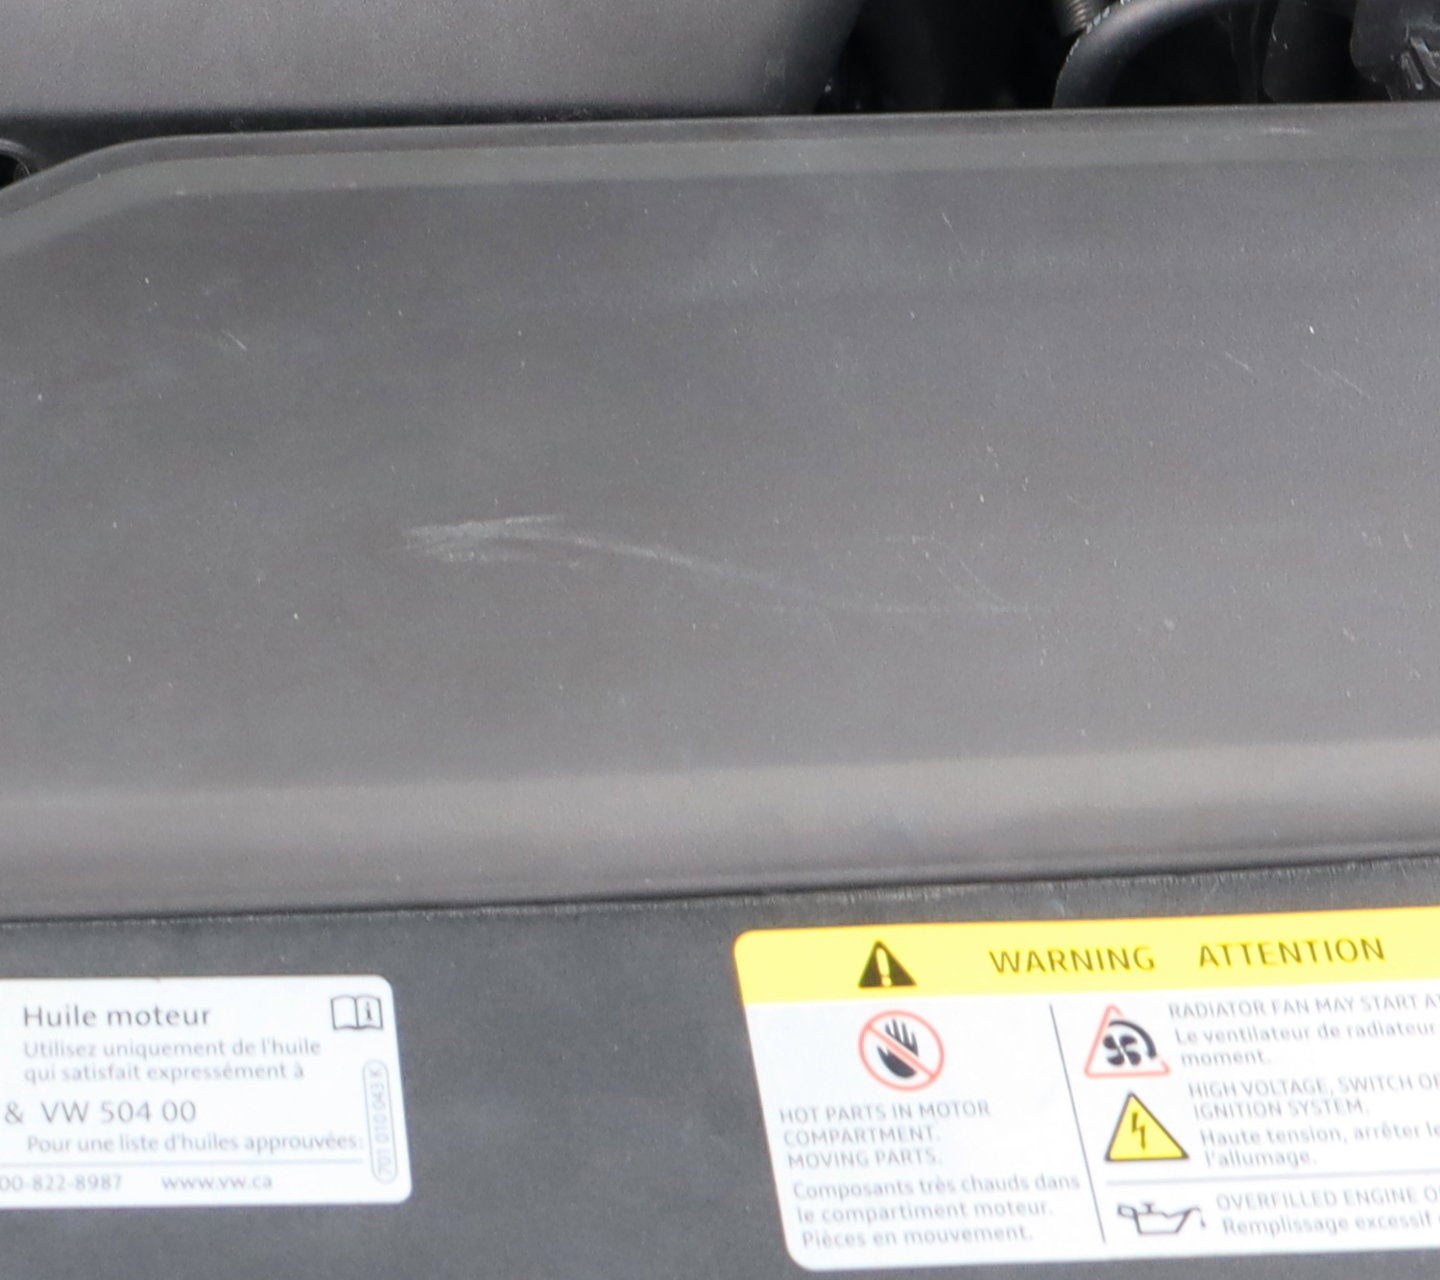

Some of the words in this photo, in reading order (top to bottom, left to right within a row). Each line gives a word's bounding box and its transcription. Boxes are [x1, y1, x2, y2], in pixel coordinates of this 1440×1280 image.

[989, 945, 1155, 976] WARNING
[1199, 936, 1386, 969] ATTENTION
[22, 1005, 97, 1028] Huile
[107, 1009, 210, 1027] moteur
[1168, 1001, 1266, 1021] RADIATOR
[1271, 998, 1309, 1016] FAN
[1316, 996, 1354, 1014] MAY
[1362, 993, 1417, 1011] START
[24, 1039, 97, 1059] Utilisez
[103, 1039, 224, 1063] uniquement
[232, 1039, 256, 1056] de
[261, 1038, 320, 1056] l'huile
[24, 1064, 56, 1085] qui
[62, 1062, 140, 1082] satisfait
[146, 1061, 286, 1085] expressément
[294, 1063, 304, 1079] à
[5, 1102, 24, 1124] &
[41, 1100, 91, 1123] VW
[100, 1099, 152, 1123] 504
[162, 1099, 197, 1121] 00
[779, 1107, 820, 1124] HOT
[825, 1104, 887, 1123] PARTS
[893, 1103, 913, 1121] IN
[919, 1099, 991, 1121] MOTOR
[1194, 1099, 1282, 1120] IGNITION
[1289, 1096, 1368, 1116] SYSTEM.
[26, 1135, 71, 1153] Pour
[78, 1137, 115, 1153] une
[120, 1134, 159, 1153] liste
[165, 1132, 238, 1152] d'huiles
[244, 1133, 364, 1155] approuvées:
[783, 1125, 941, 1150] COMPARTMENT.
[788, 1150, 869, 1171] MOVING
[874, 1148, 943, 1169] PARTS.
[161, 1175, 272, 1192] www.vw.ca
[793, 1180, 912, 1204] Composants
[920, 1176, 955, 1195] très
[964, 1174, 1029, 1194] chauds
[1036, 1173, 1080, 1192] dans
[798, 1205, 815, 1224] le
[822, 1200, 967, 1225] compartiment
[975, 1198, 1053, 1218] moteur.
[802, 1227, 866, 1249] Pièces
[874, 1227, 896, 1247] en
[904, 1222, 1034, 1246] mouvement.
